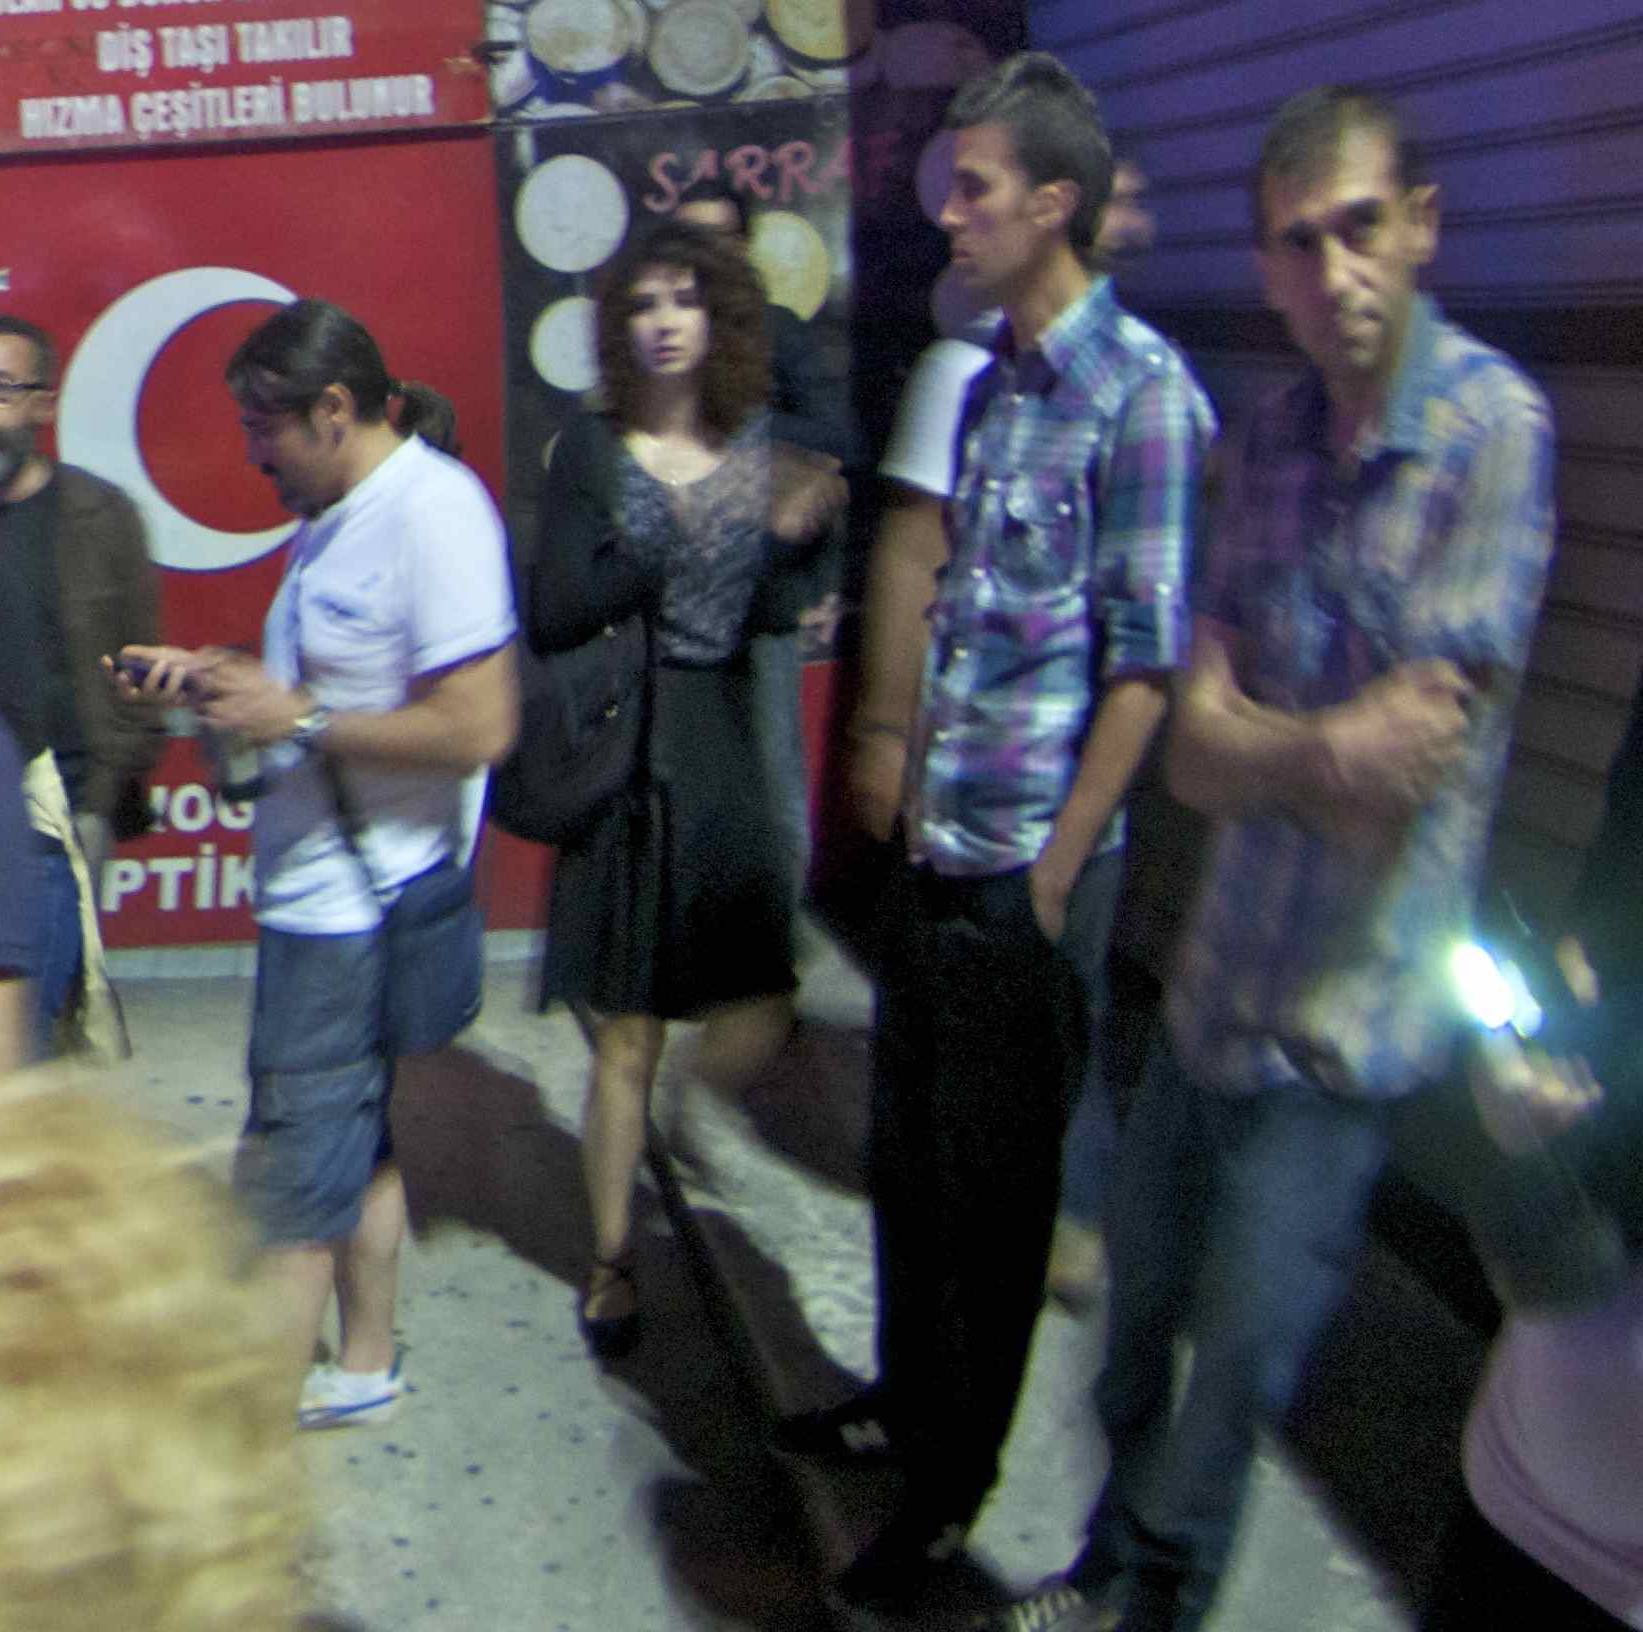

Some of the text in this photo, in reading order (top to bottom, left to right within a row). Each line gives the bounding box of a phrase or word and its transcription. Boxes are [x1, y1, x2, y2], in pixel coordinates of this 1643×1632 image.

[96, 15, 354, 77] DİŞ TAŞI TAKILIR
[19, 73, 436, 140] HIZMA ÇEŞİTLERİ BULUNUR
[100, 842, 257, 914] PTİK
